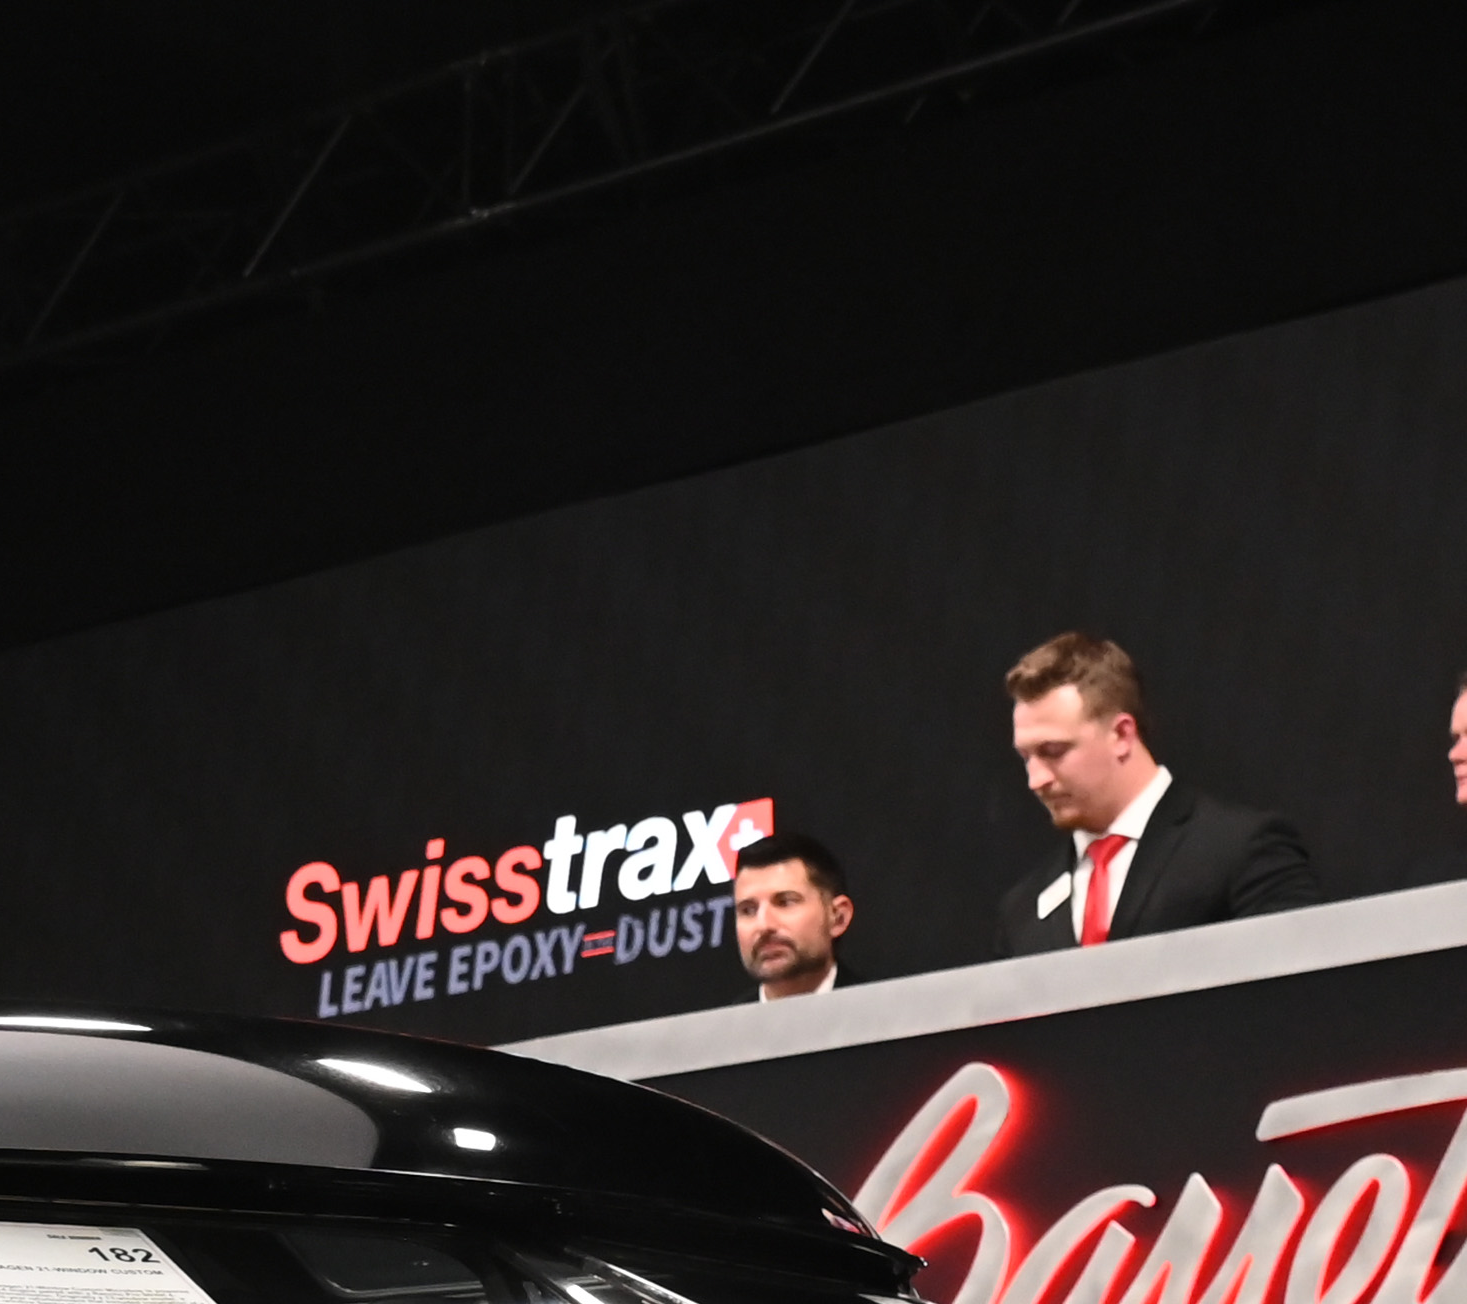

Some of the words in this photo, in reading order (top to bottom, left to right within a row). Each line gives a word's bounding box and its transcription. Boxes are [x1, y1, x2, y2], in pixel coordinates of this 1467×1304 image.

[279, 803, 738, 965] Swisstrax
[317, 950, 438, 1019] LEAVE
[446, 923, 586, 996] EPOXY
[612, 896, 735, 965] DUST
[35, 1265, 108, 1275] 21-WINDOW
[110, 1268, 165, 1276] CUSTOM
[88, 1246, 162, 1264] 182
